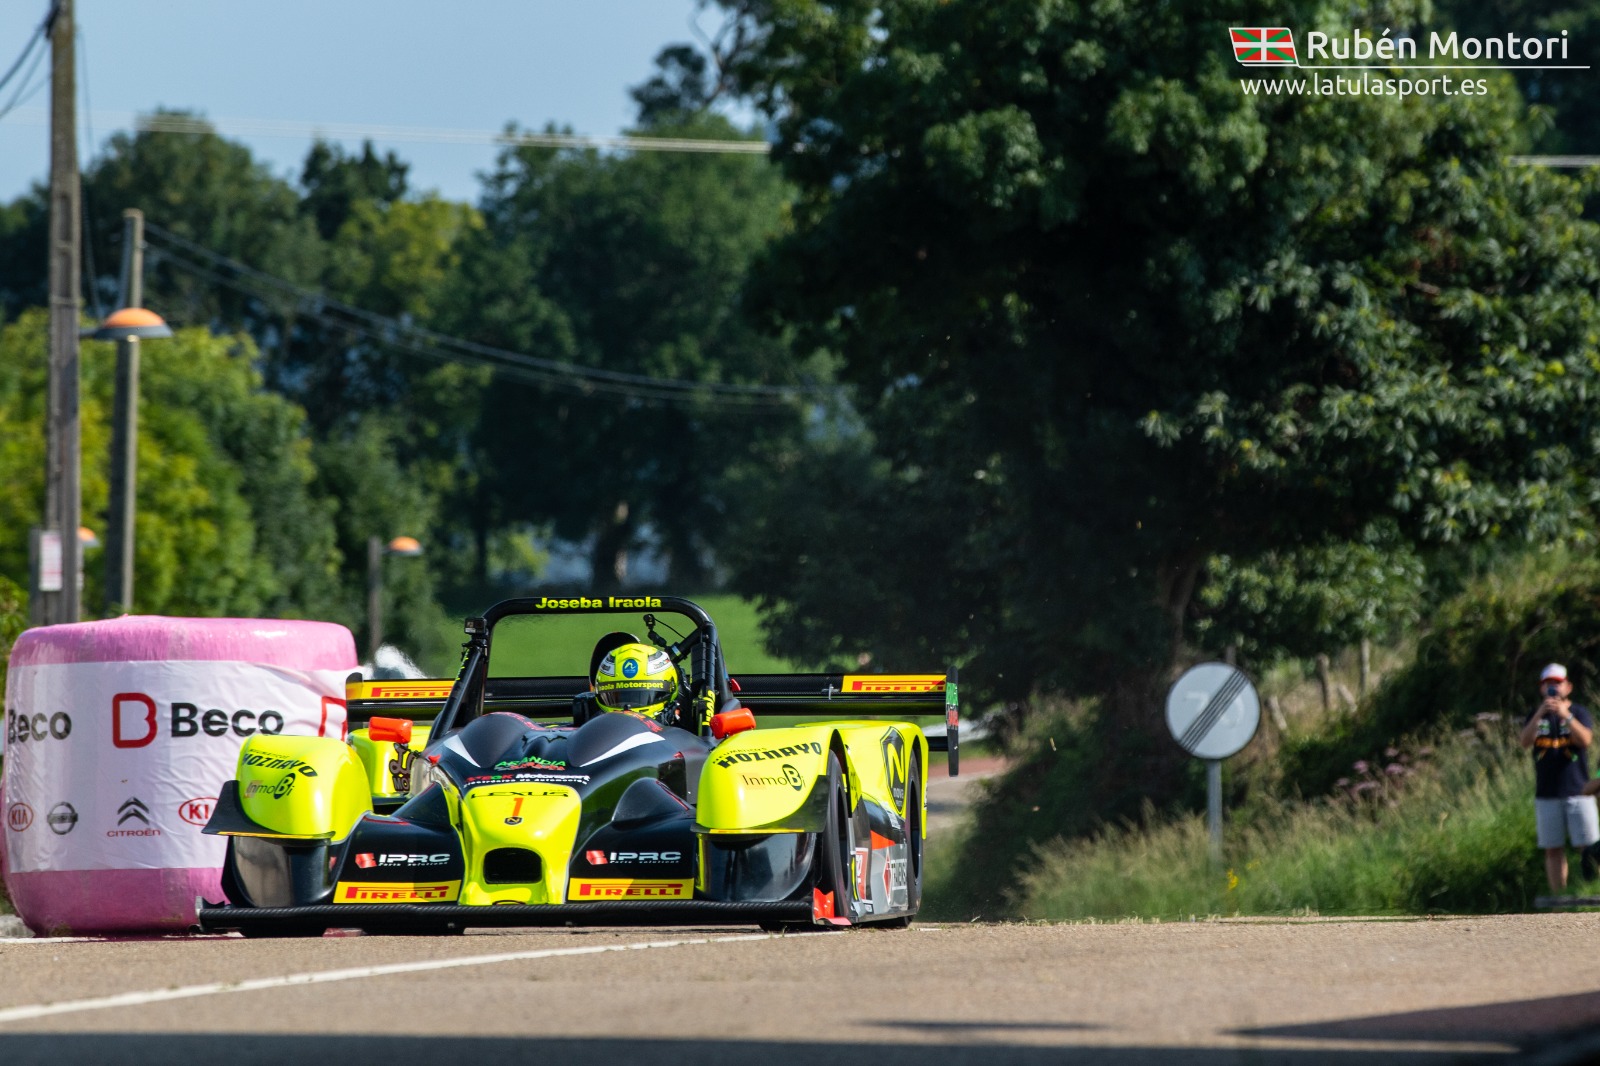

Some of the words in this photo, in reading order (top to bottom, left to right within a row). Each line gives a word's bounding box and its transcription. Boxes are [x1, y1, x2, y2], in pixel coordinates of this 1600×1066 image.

[535, 597, 603, 609] Joseba
[608, 596, 662, 608] Iraola
[616, 682, 664, 690] Motorsport
[852, 680, 946, 691] PIRELLI
[8, 708, 72, 745] Beco
[171, 702, 284, 738] Beco
[717, 741, 822, 769] HOZNAYO
[515, 773, 591, 782] Motorsport
[470, 791, 569, 799] LEXUS
[188, 803, 210, 820] KI
[511, 797, 524, 817] 1
[378, 853, 451, 863] IPRC
[609, 851, 682, 861] IPRC
[345, 886, 450, 899] PIRELLI
[579, 883, 684, 896] PIRELLI
